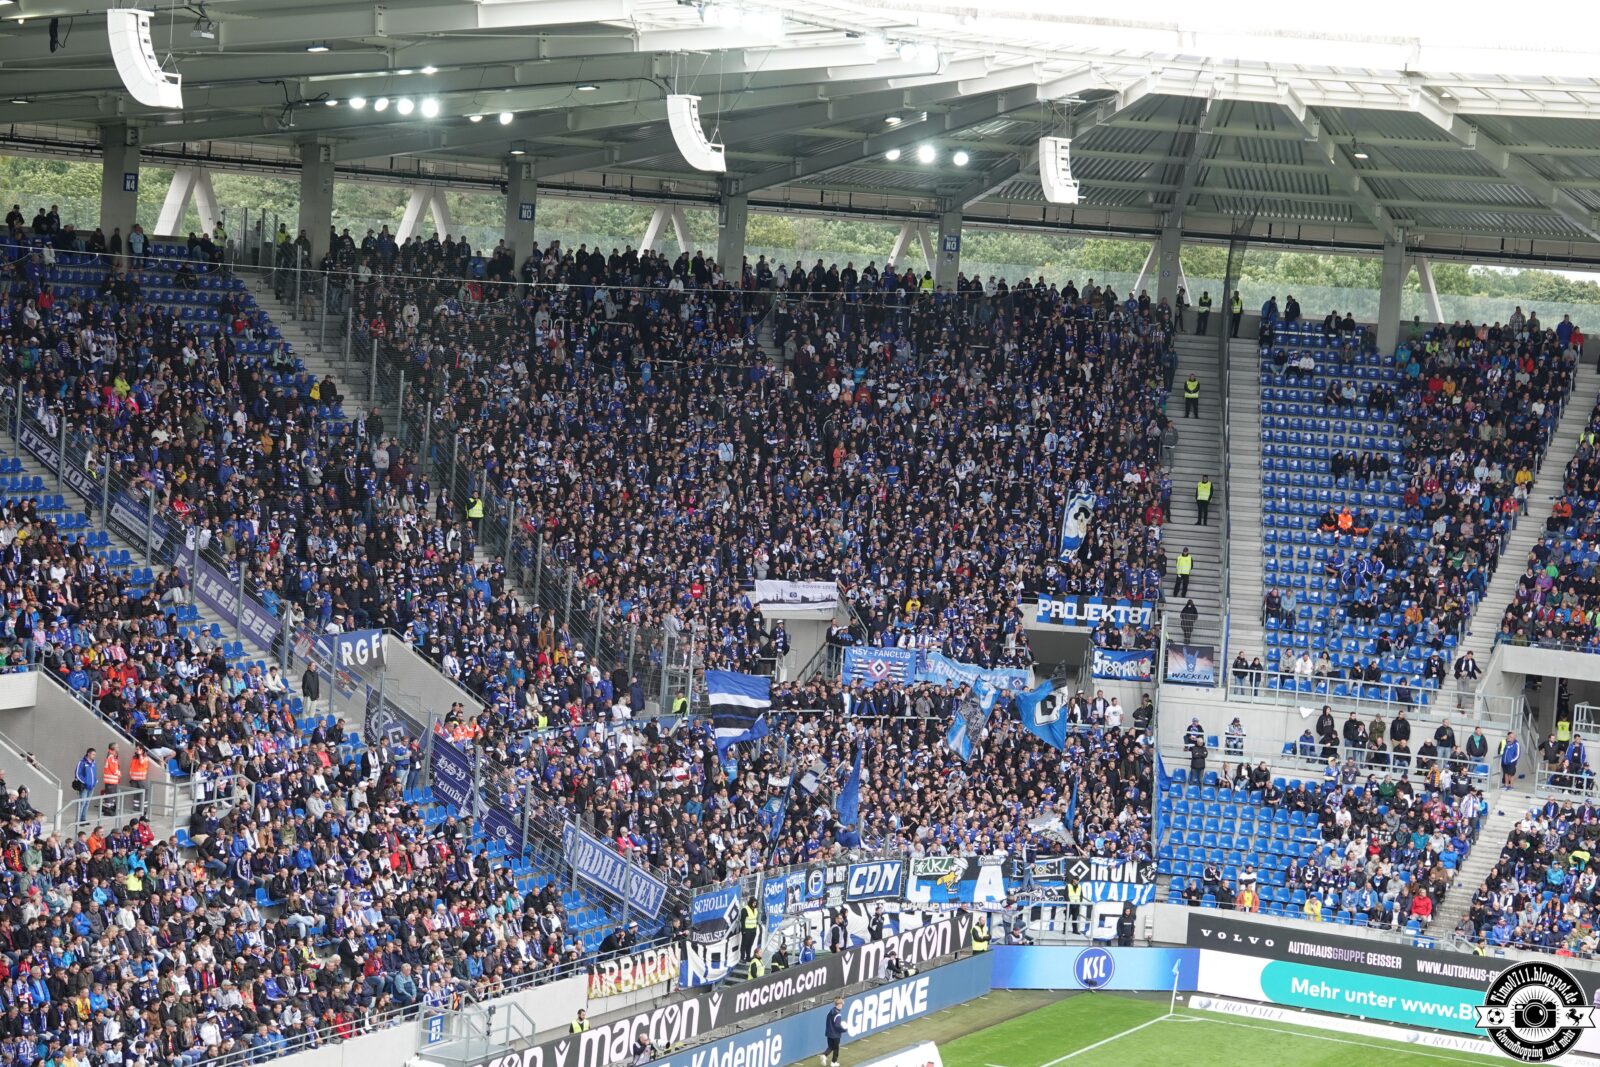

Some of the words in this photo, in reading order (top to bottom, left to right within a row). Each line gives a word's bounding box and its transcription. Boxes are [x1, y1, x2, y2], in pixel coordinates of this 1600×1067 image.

[174, 553, 276, 642] FLKENSEE
[1037, 599, 1151, 624] PROJEKT87
[874, 649, 910, 659] FANCLUB
[1172, 671, 1210, 681] WACKEN
[848, 864, 899, 895] CDN
[1090, 861, 1138, 883] IRON
[694, 894, 728, 914] SCHOLLI
[1081, 881, 1153, 905] OYALTY
[1201, 928, 1275, 947] VOLVO
[857, 918, 952, 984] macron
[1288, 941, 1365, 963] AUTOHAUSGRUPPE
[1367, 952, 1402, 969] GEISSER
[1083, 955, 1107, 980] KSC
[735, 965, 827, 1013] macron.com
[1291, 977, 1340, 999] Mehr
[1345, 988, 1397, 1009] unter
[847, 976, 930, 1036] GRENKE
[1214, 1001, 1286, 1020] CRONIMET
[577, 997, 700, 1067] macron
[1422, 1035, 1496, 1054] CRONIMET
